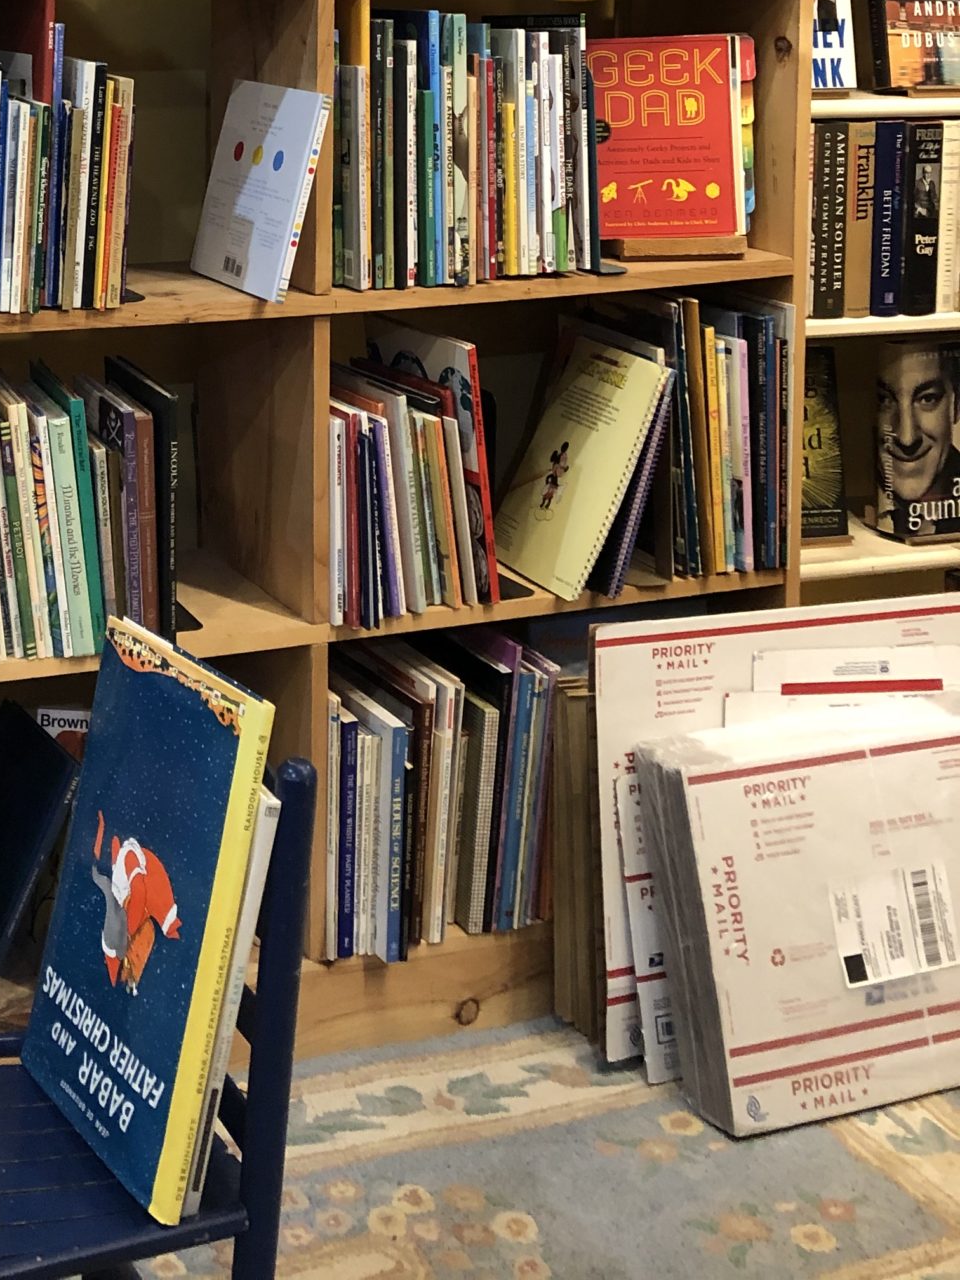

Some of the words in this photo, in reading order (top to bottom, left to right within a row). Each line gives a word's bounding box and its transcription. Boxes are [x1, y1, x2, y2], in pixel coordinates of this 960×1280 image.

[901, 32, 955, 48] DUBUS
[588, 48, 724, 88] GEEK
[604, 89, 705, 128] DAD
[40, 156, 48, 177] Simple
[823, 133, 831, 188] GENERAL
[835, 132, 846, 216] AMERICAN
[39, 179, 47, 203] Kitchen
[91, 165, 99, 206] HEAVENLY
[855, 144, 875, 220] Franklin
[37, 205, 45, 244] Experiments
[821, 196, 829, 238] TOMMY
[883, 190, 892, 223] BETTY
[833, 222, 843, 290] SOLDIER
[880, 225, 891, 278] FRIEDAN
[915, 234, 937, 245] Peter
[12, 521, 21, 538] PET
[15, 542, 24, 559] BOY
[652, 643, 714, 659] PRIORITY
[666, 659, 699, 670] MAIL
[243, 788, 258, 832] RANDOM
[252, 748, 265, 785] HOUSE
[743, 777, 809, 799] PRIORITY
[761, 796, 796, 809] MAIL
[392, 798, 401, 839] HOUSE
[393, 842, 400, 852] OF
[390, 857, 401, 912] SCIENCE
[711, 883, 729, 939] MAIL
[722, 855, 751, 963] PRIORITY
[43, 965, 111, 1053] CHRISTMAS
[196, 1057, 209, 1095] BABAR
[203, 1030, 213, 1055] AND
[208, 989, 221, 1029] FATHER
[216, 926, 233, 987] CHRISTMAS
[51, 1021, 77, 1056] AND
[109, 1035, 165, 1109] FATHER
[791, 1063, 872, 1097] PRIORITY
[78, 1052, 135, 1133] BABAR
[813, 1089, 857, 1110] MAIL
